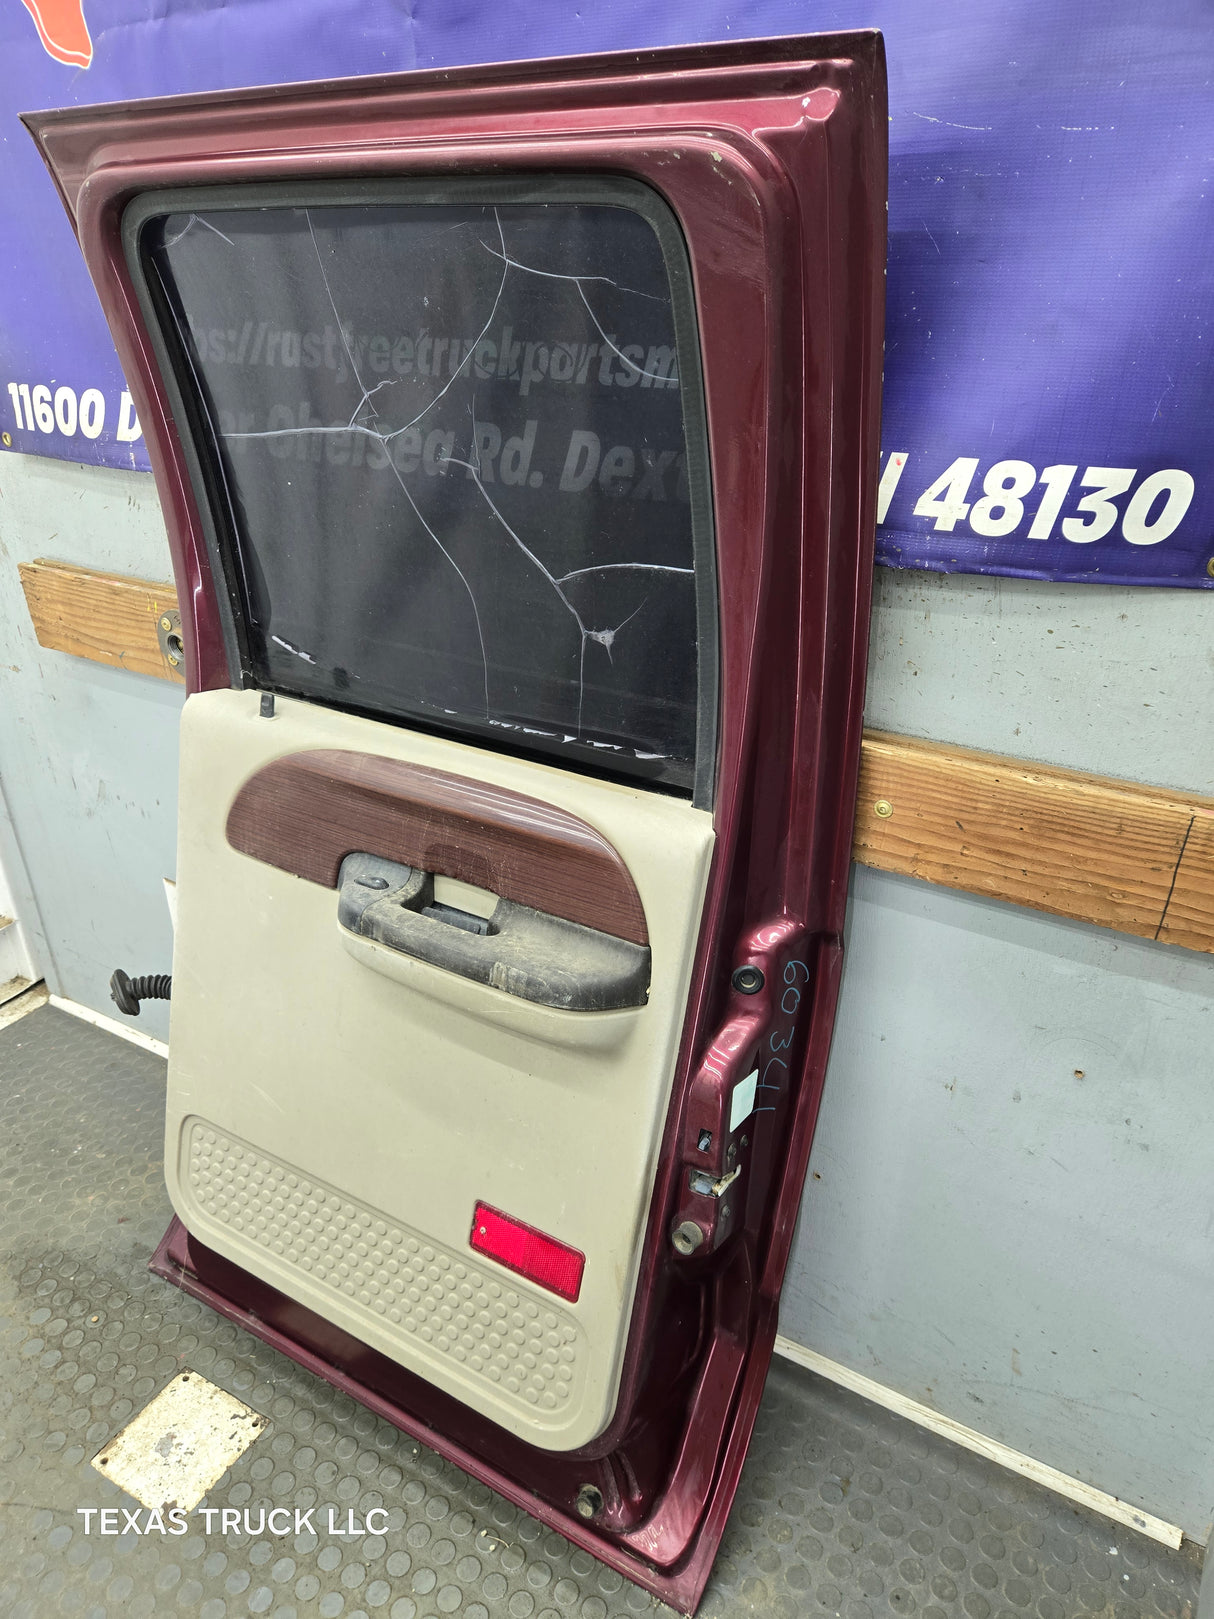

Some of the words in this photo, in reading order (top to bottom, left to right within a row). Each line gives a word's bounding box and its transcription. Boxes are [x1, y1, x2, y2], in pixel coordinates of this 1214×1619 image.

[7, 382, 105, 439] 11600
[267, 402, 456, 476] Chelsea
[466, 420, 544, 489] Rd.
[913, 457, 1195, 545] 48130
